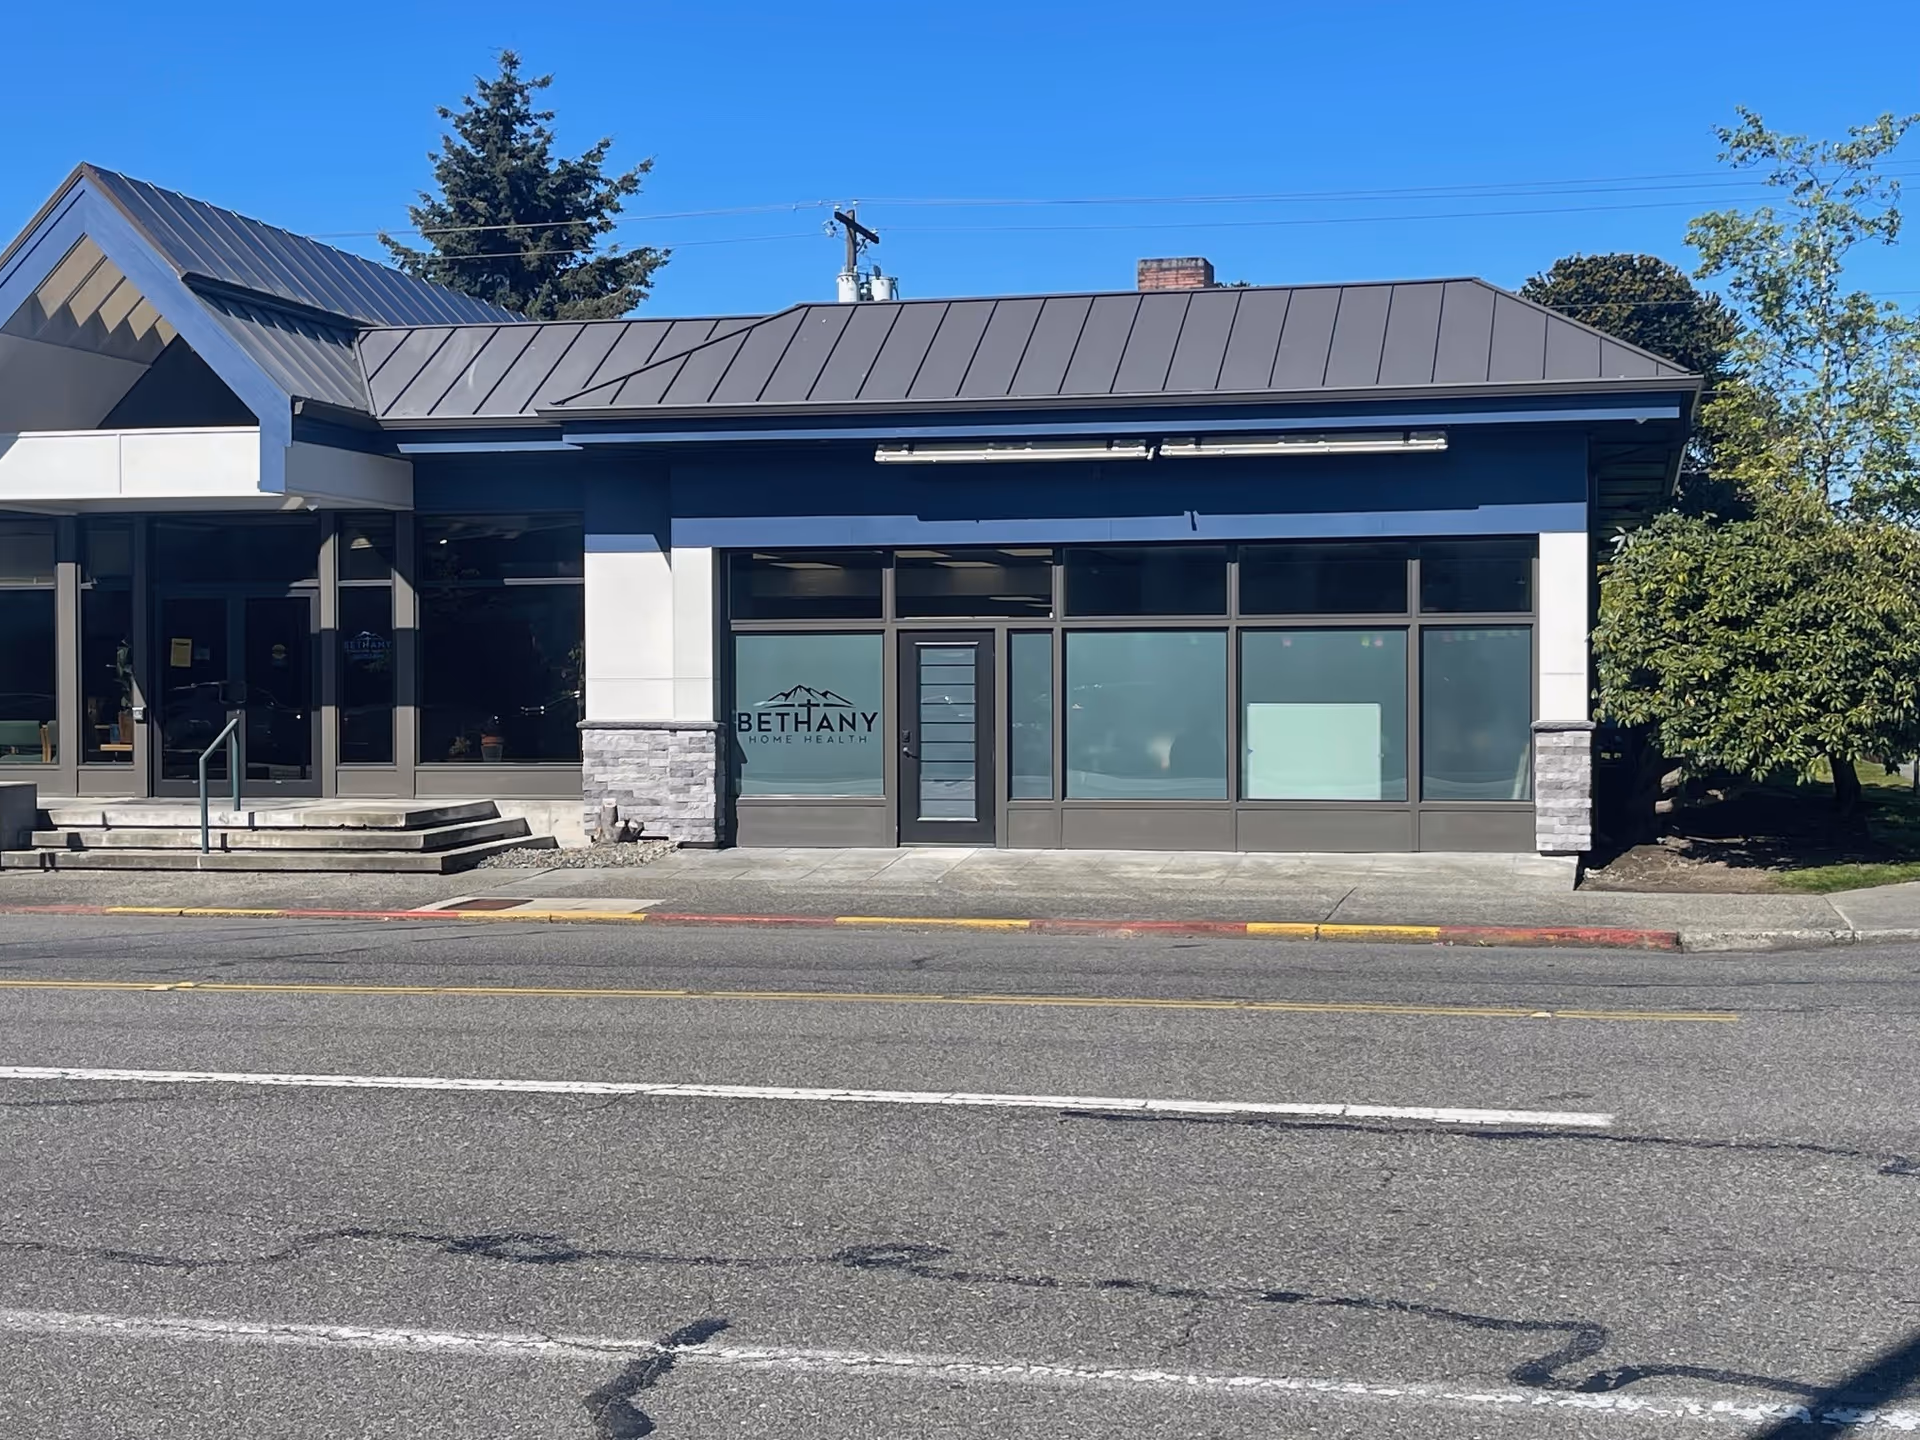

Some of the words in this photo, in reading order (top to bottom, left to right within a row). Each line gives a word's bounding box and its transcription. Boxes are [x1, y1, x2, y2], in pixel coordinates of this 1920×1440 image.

[737, 711, 879, 732] BETHANY
[748, 734, 793, 744] HOME
[804, 734, 868, 744] HEALTH
